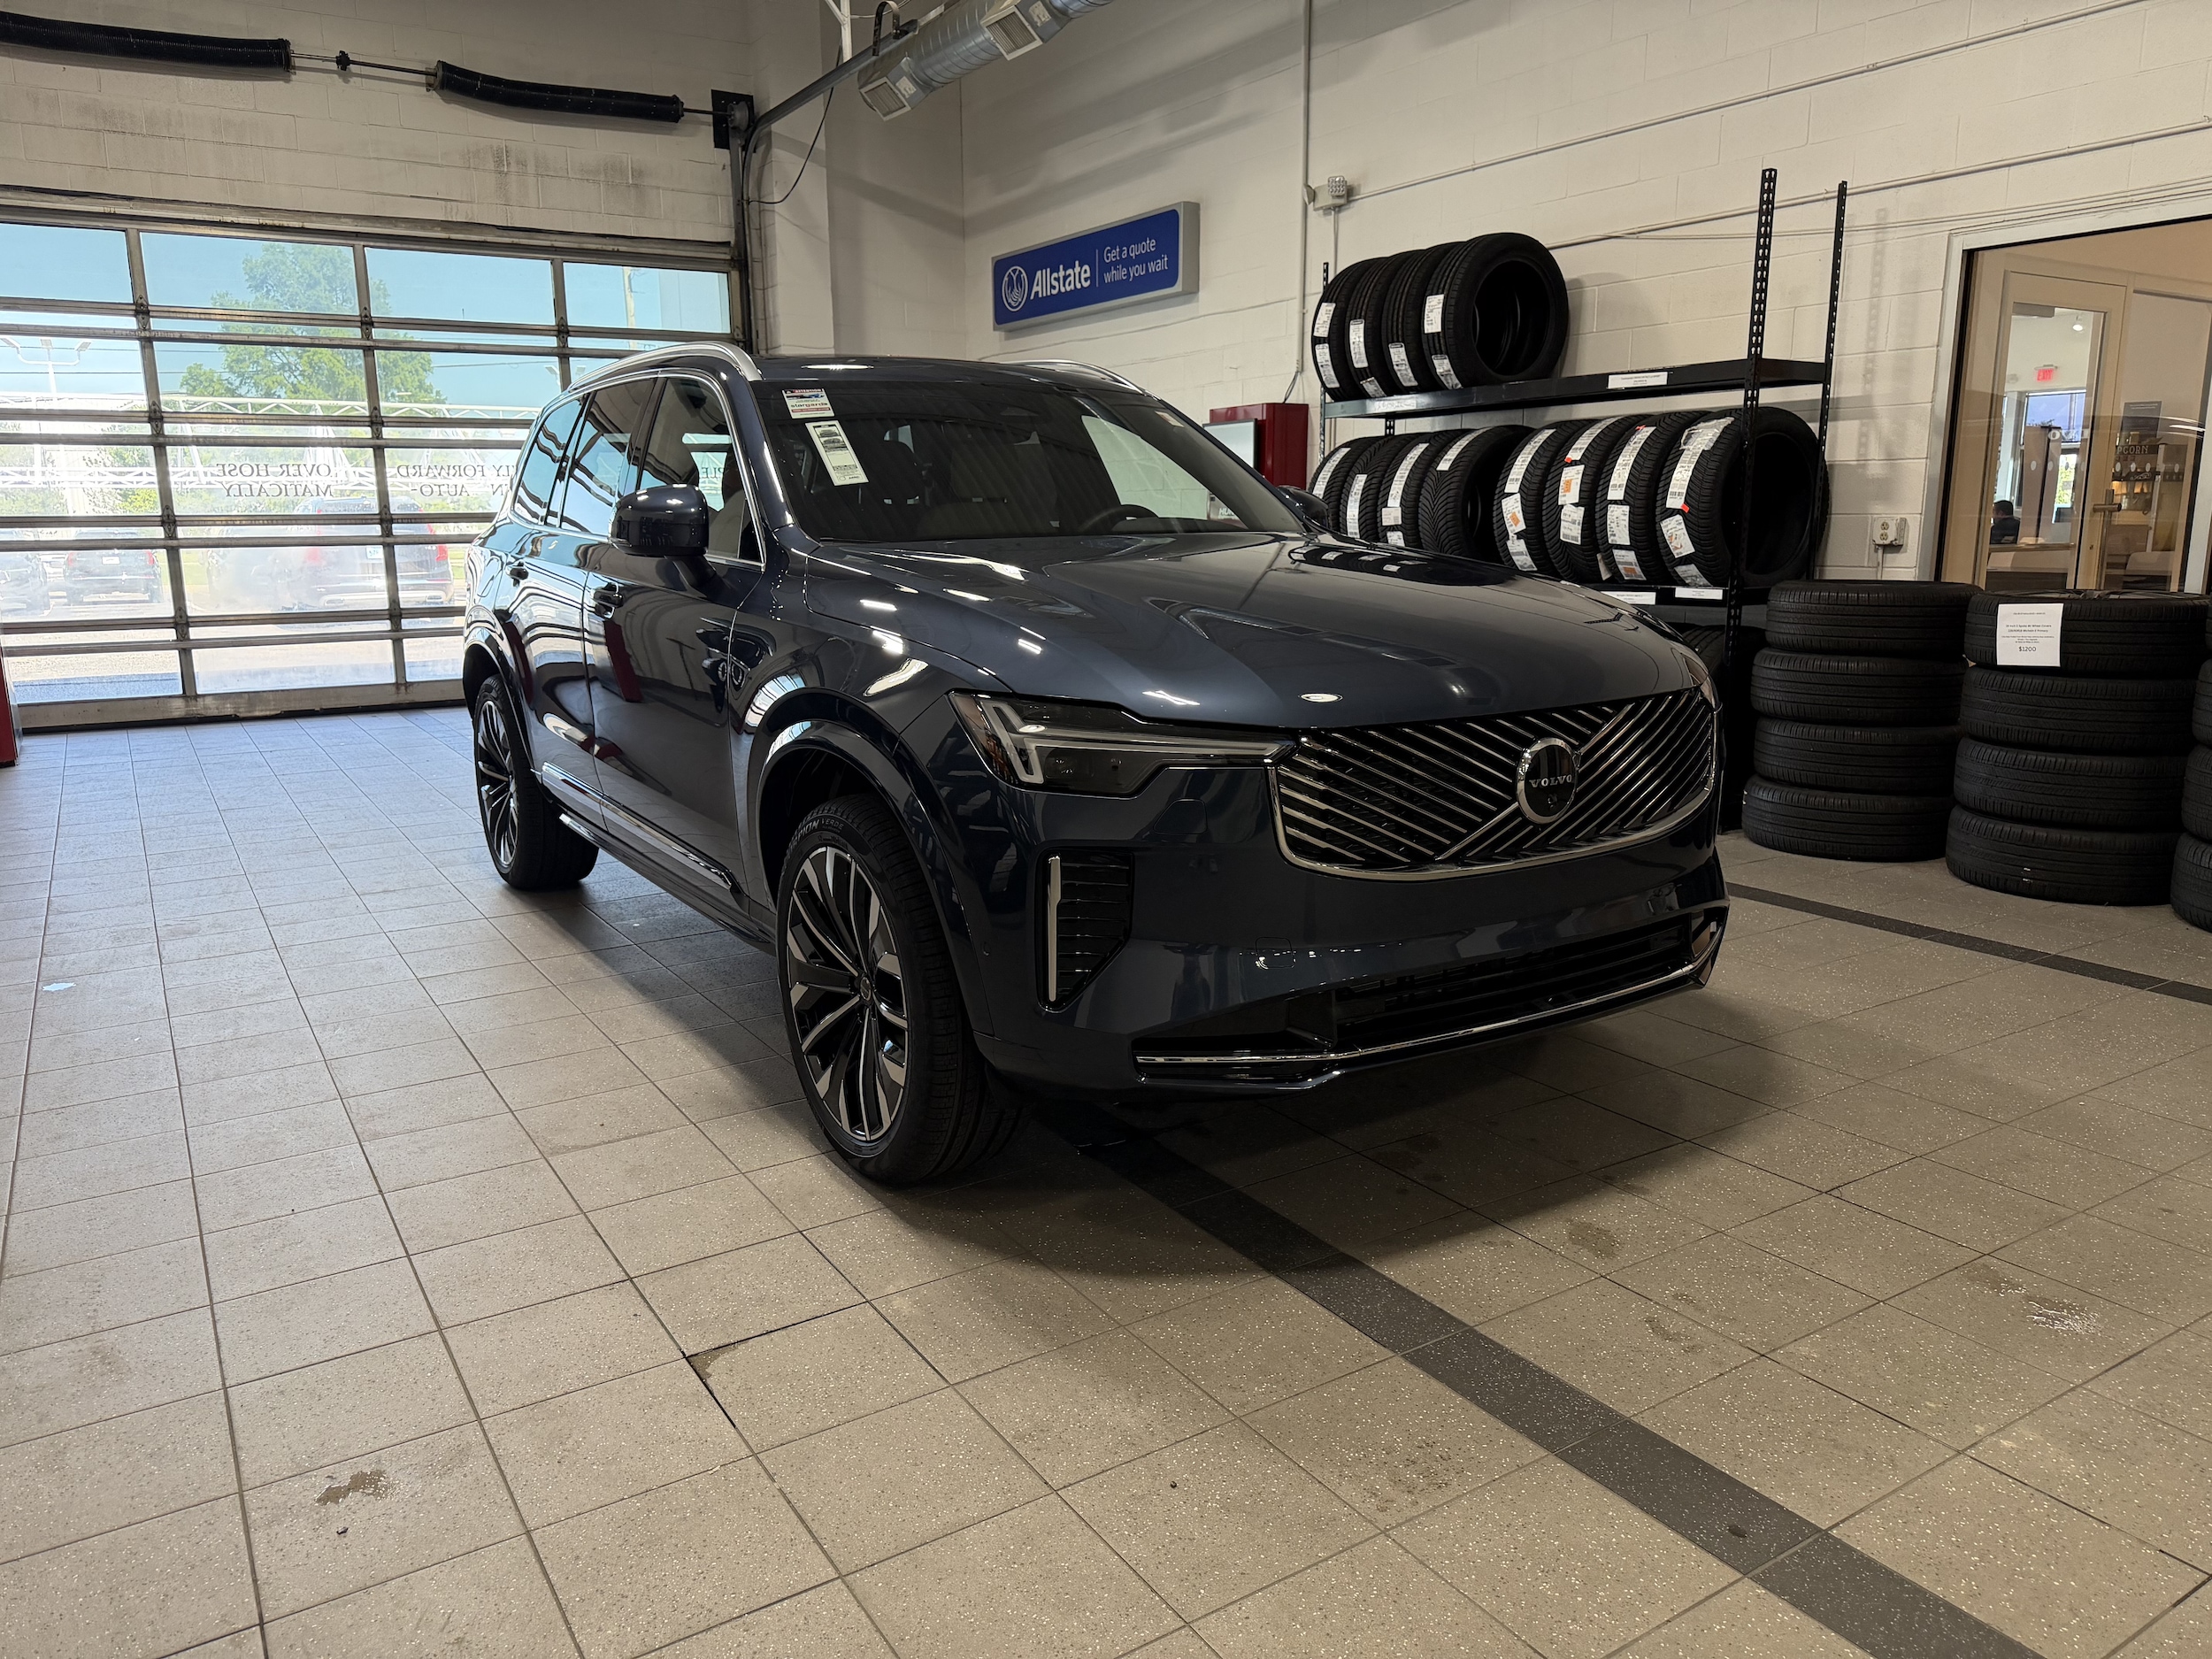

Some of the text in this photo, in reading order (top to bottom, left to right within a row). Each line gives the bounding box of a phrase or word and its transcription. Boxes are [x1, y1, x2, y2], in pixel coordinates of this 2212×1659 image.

[1103, 237, 1156, 263] Get a quote
[1104, 255, 1169, 283] while you wait
[1030, 260, 1091, 299] Allstate
[2037, 368, 2054, 382] EXIT
[2116, 445, 2149, 455] PCORN
[1529, 774, 1572, 788] VOLVO
